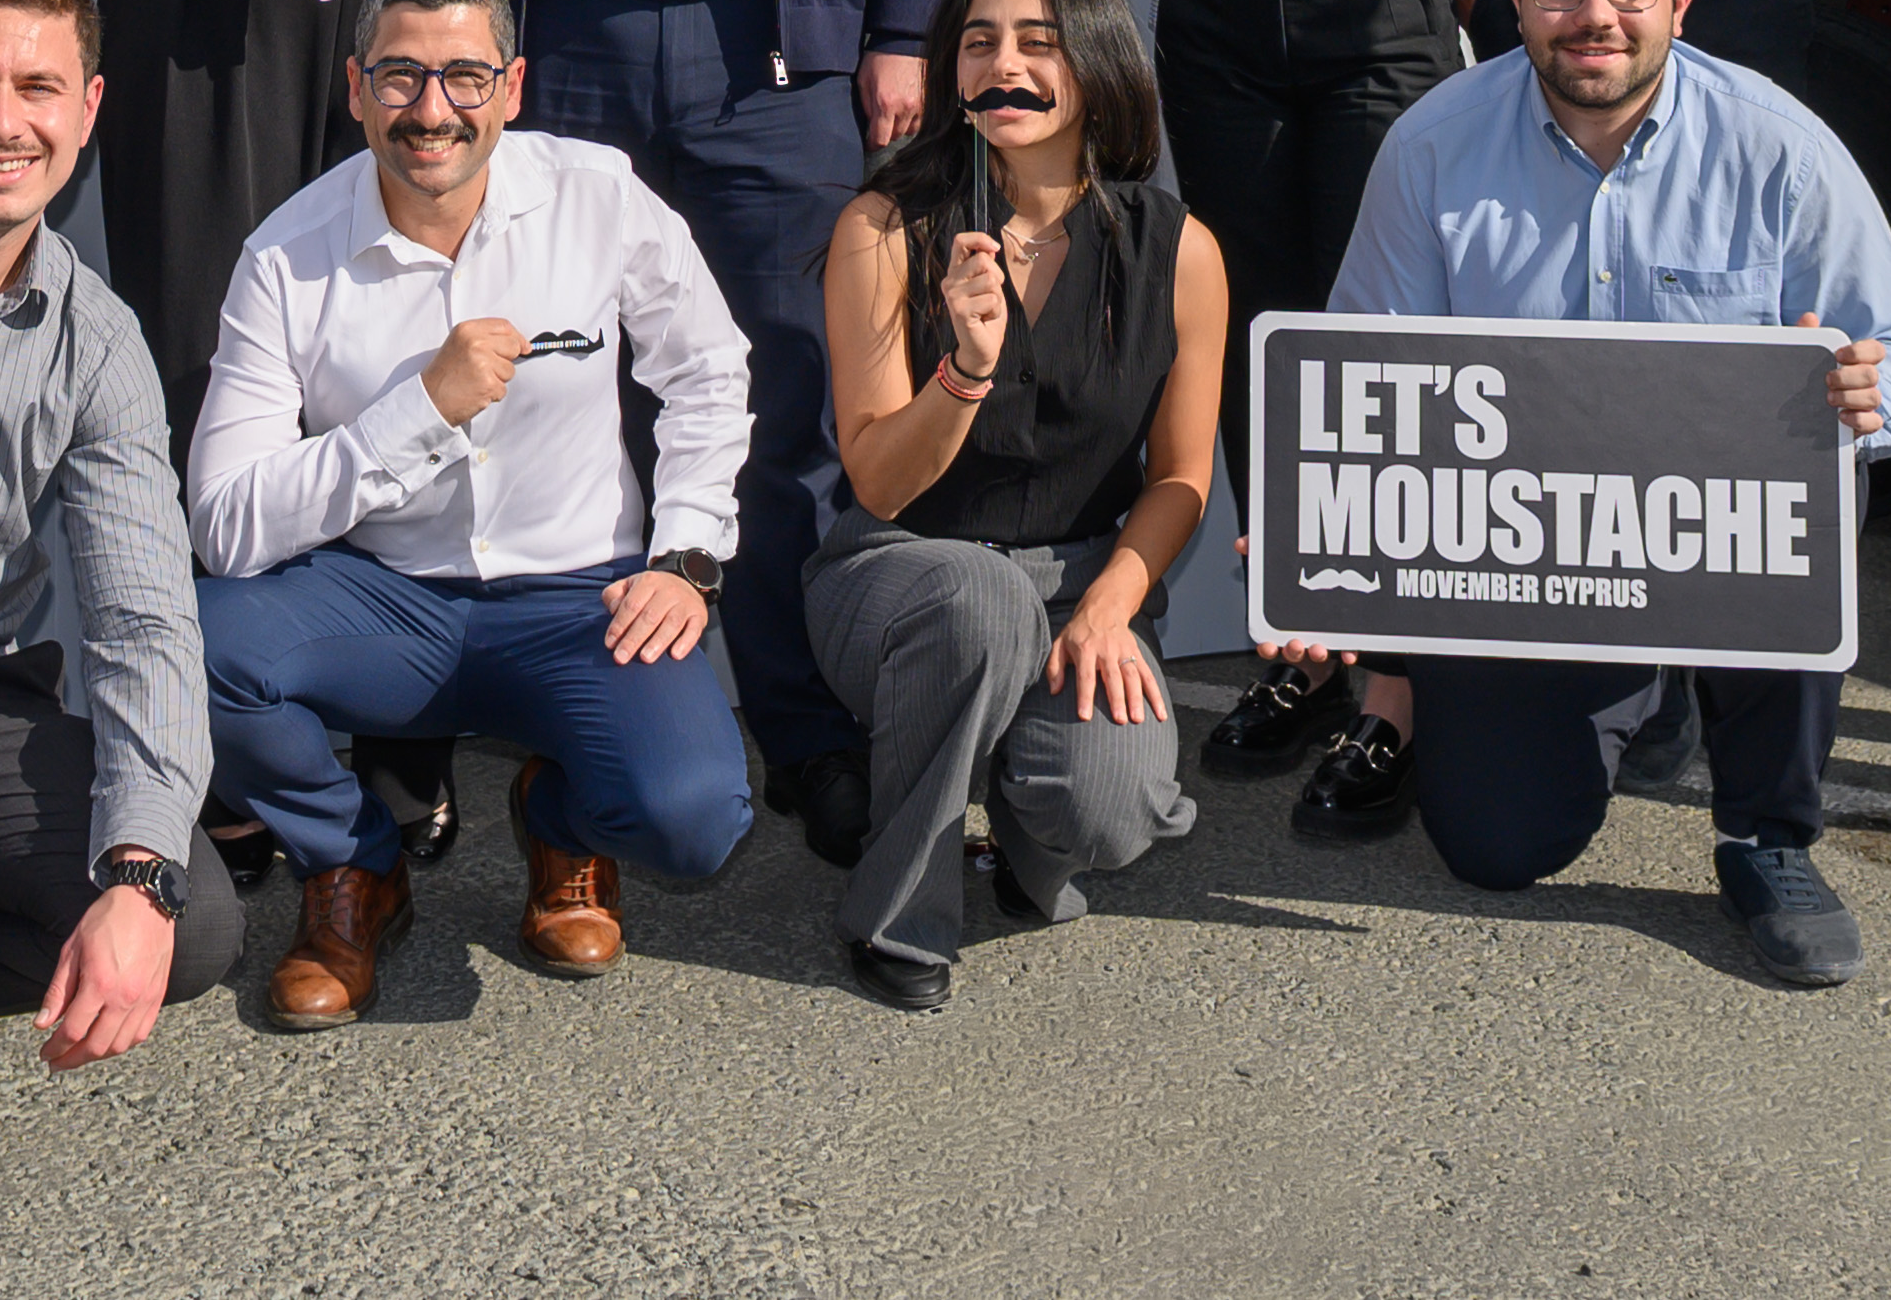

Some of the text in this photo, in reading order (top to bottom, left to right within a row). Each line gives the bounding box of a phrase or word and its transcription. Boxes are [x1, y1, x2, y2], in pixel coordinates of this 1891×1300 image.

[1299, 359, 1508, 460] LET'S
[1298, 461, 1810, 576] MOUSTACHE
[1396, 567, 1649, 609] MOVEMBER CYPRUS
